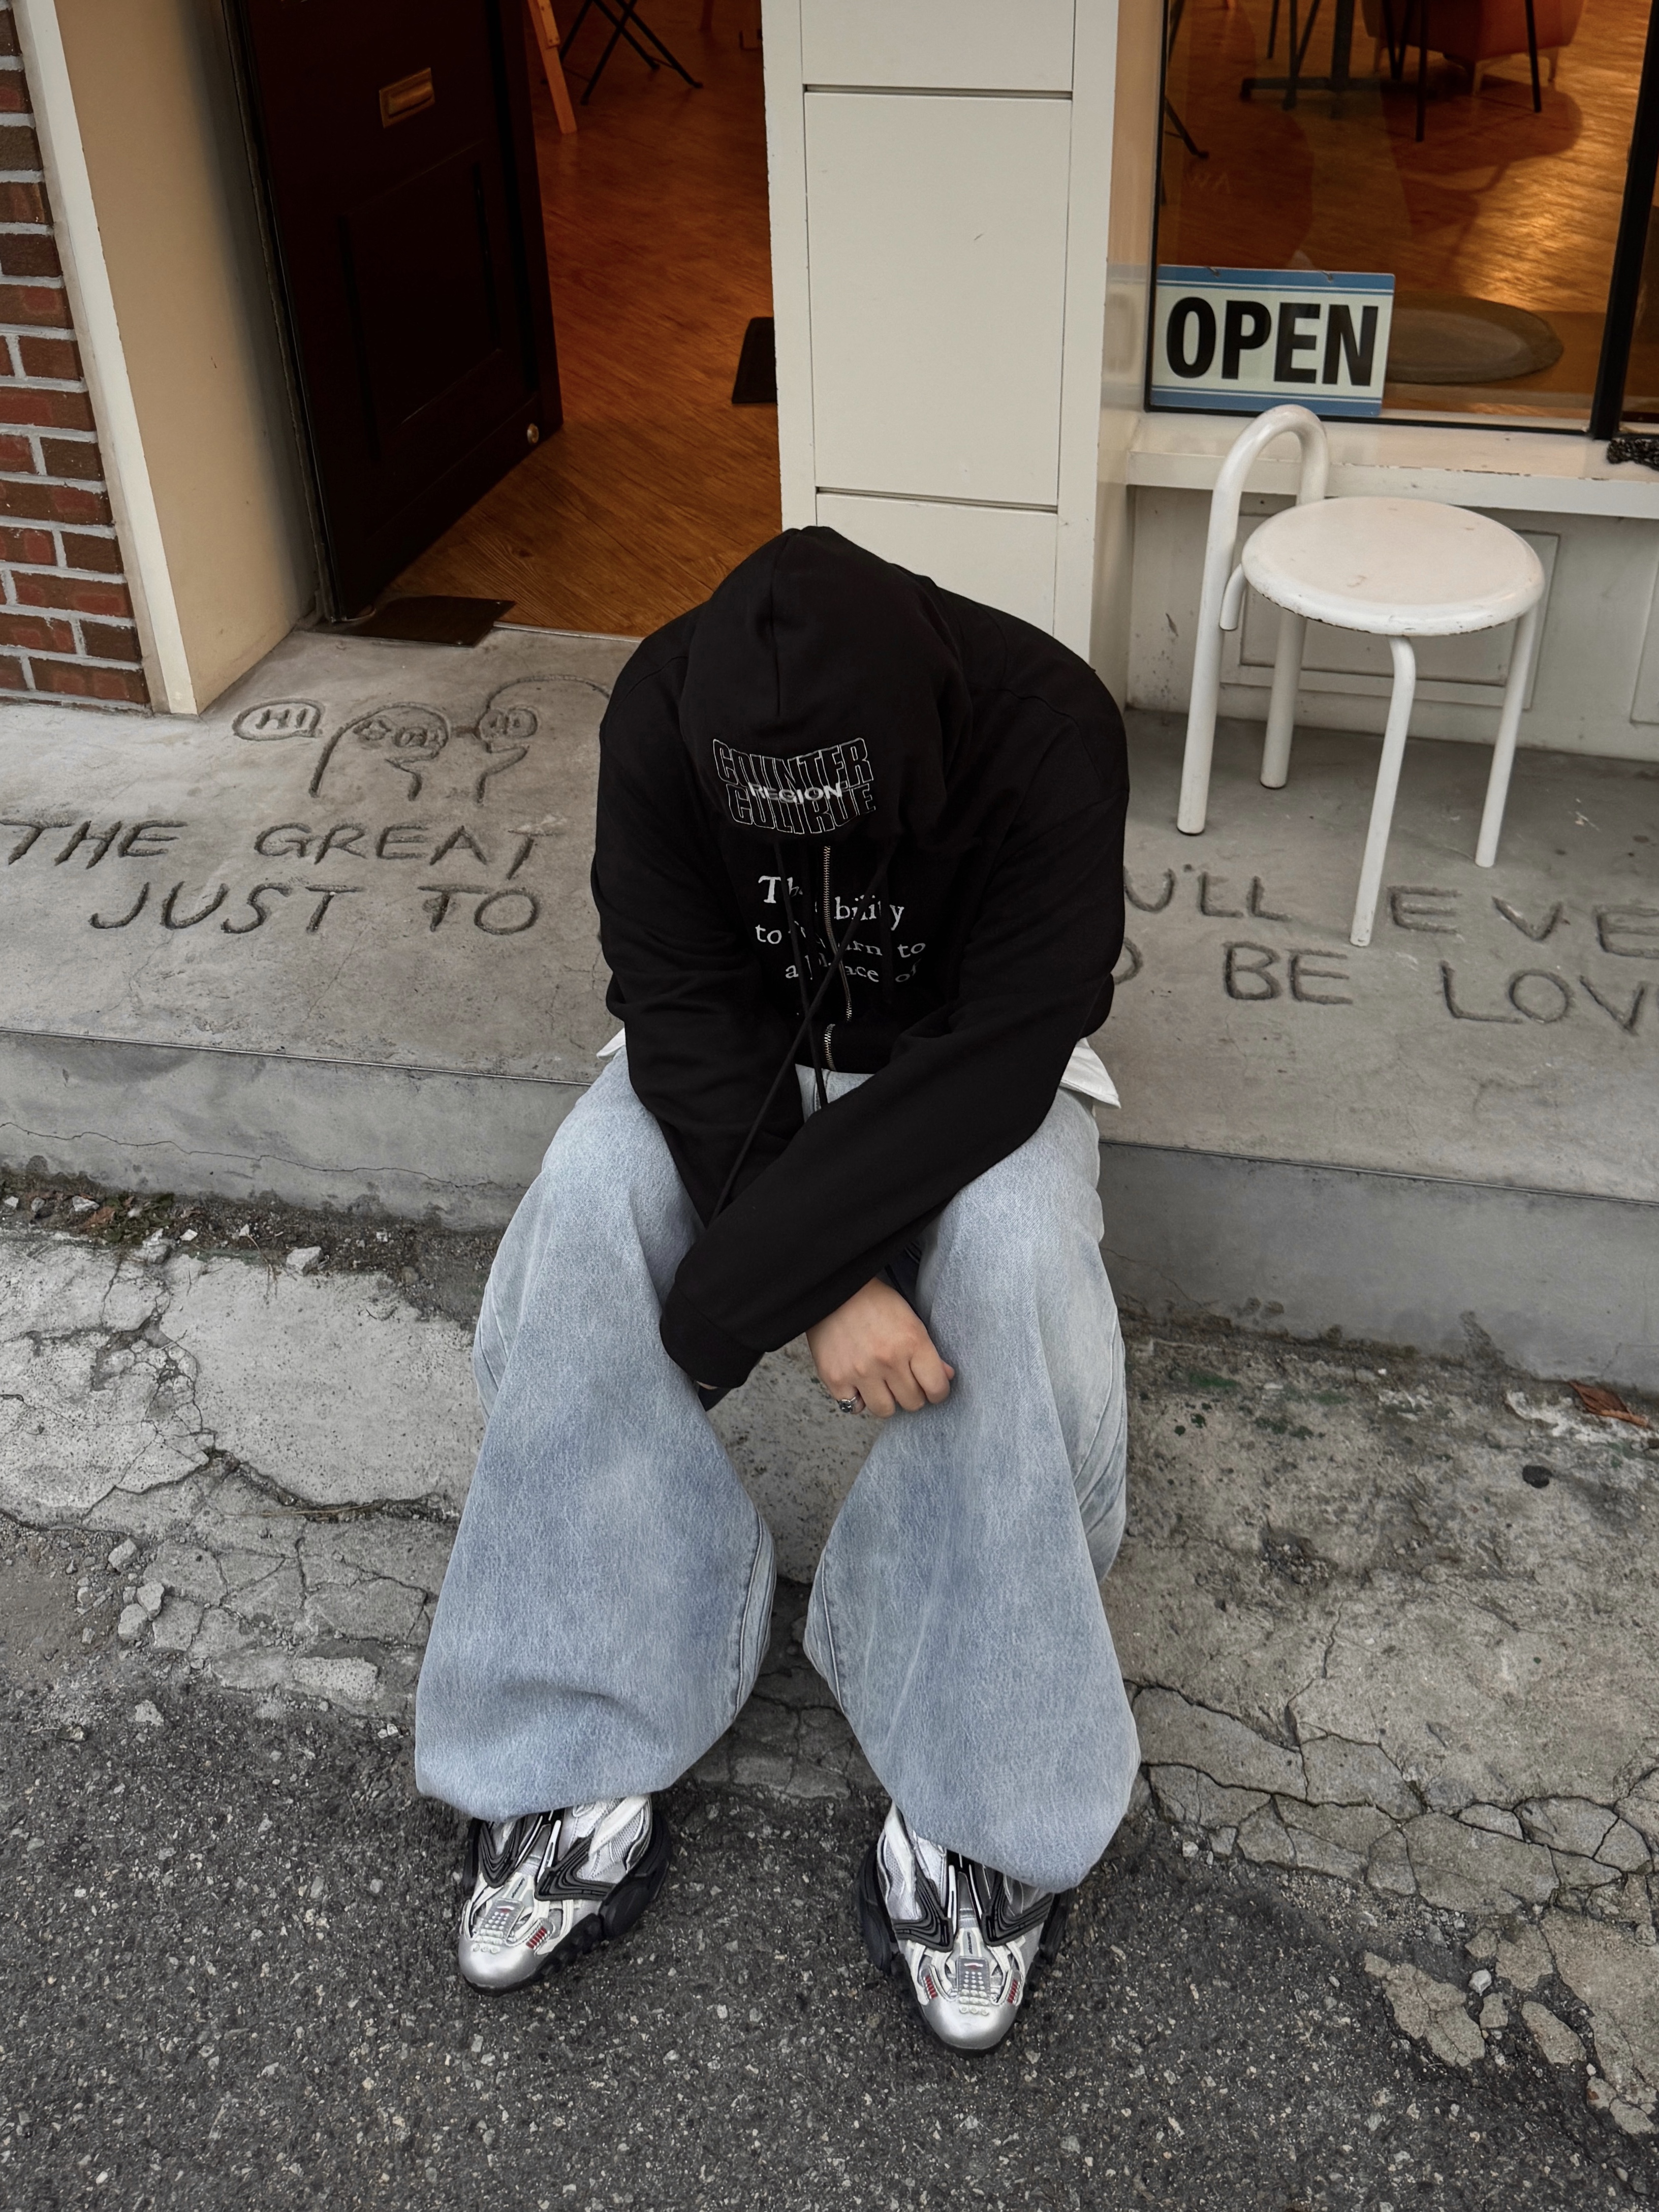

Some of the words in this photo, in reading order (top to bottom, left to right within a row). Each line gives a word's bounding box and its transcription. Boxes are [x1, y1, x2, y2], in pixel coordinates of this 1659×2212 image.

[1166, 296, 1379, 387] OPEN
[0, 819, 189, 868] THE
[254, 821, 563, 880] GREAT
[89, 881, 365, 933] JUST
[417, 884, 540, 934] TO
[1224, 941, 1353, 1005] BE
[1439, 961, 1659, 1037] LOV
[755, 923, 782, 945] to
[897, 942, 927, 958] to
